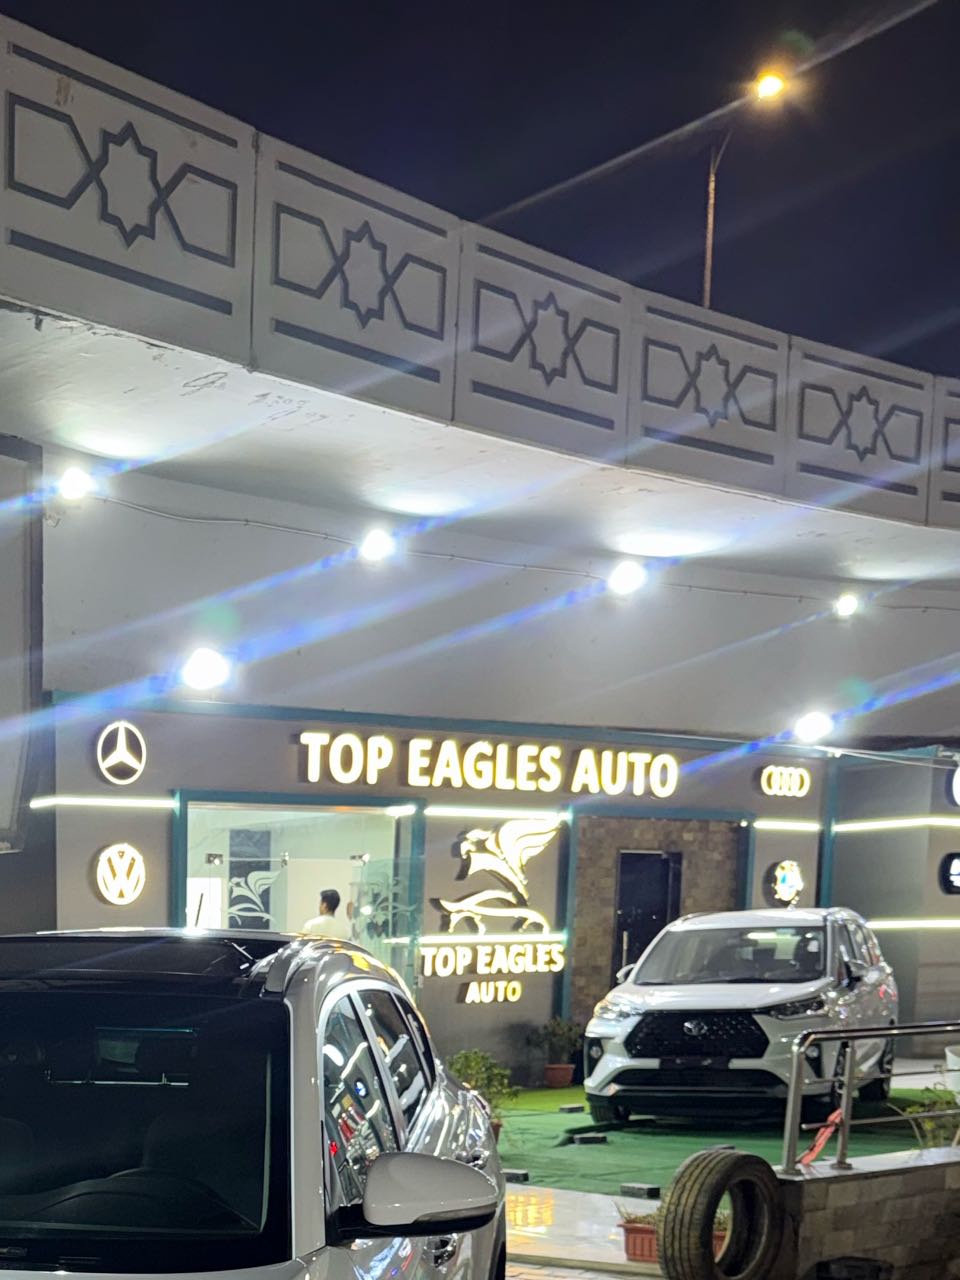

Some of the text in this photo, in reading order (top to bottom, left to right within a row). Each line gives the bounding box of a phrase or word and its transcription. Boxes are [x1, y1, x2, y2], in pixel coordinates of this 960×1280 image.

[300, 731, 679, 798] TOP EAGLES AUTO
[420, 943, 565, 977] TOP EAGLES
[465, 980, 522, 1004] AUTO
